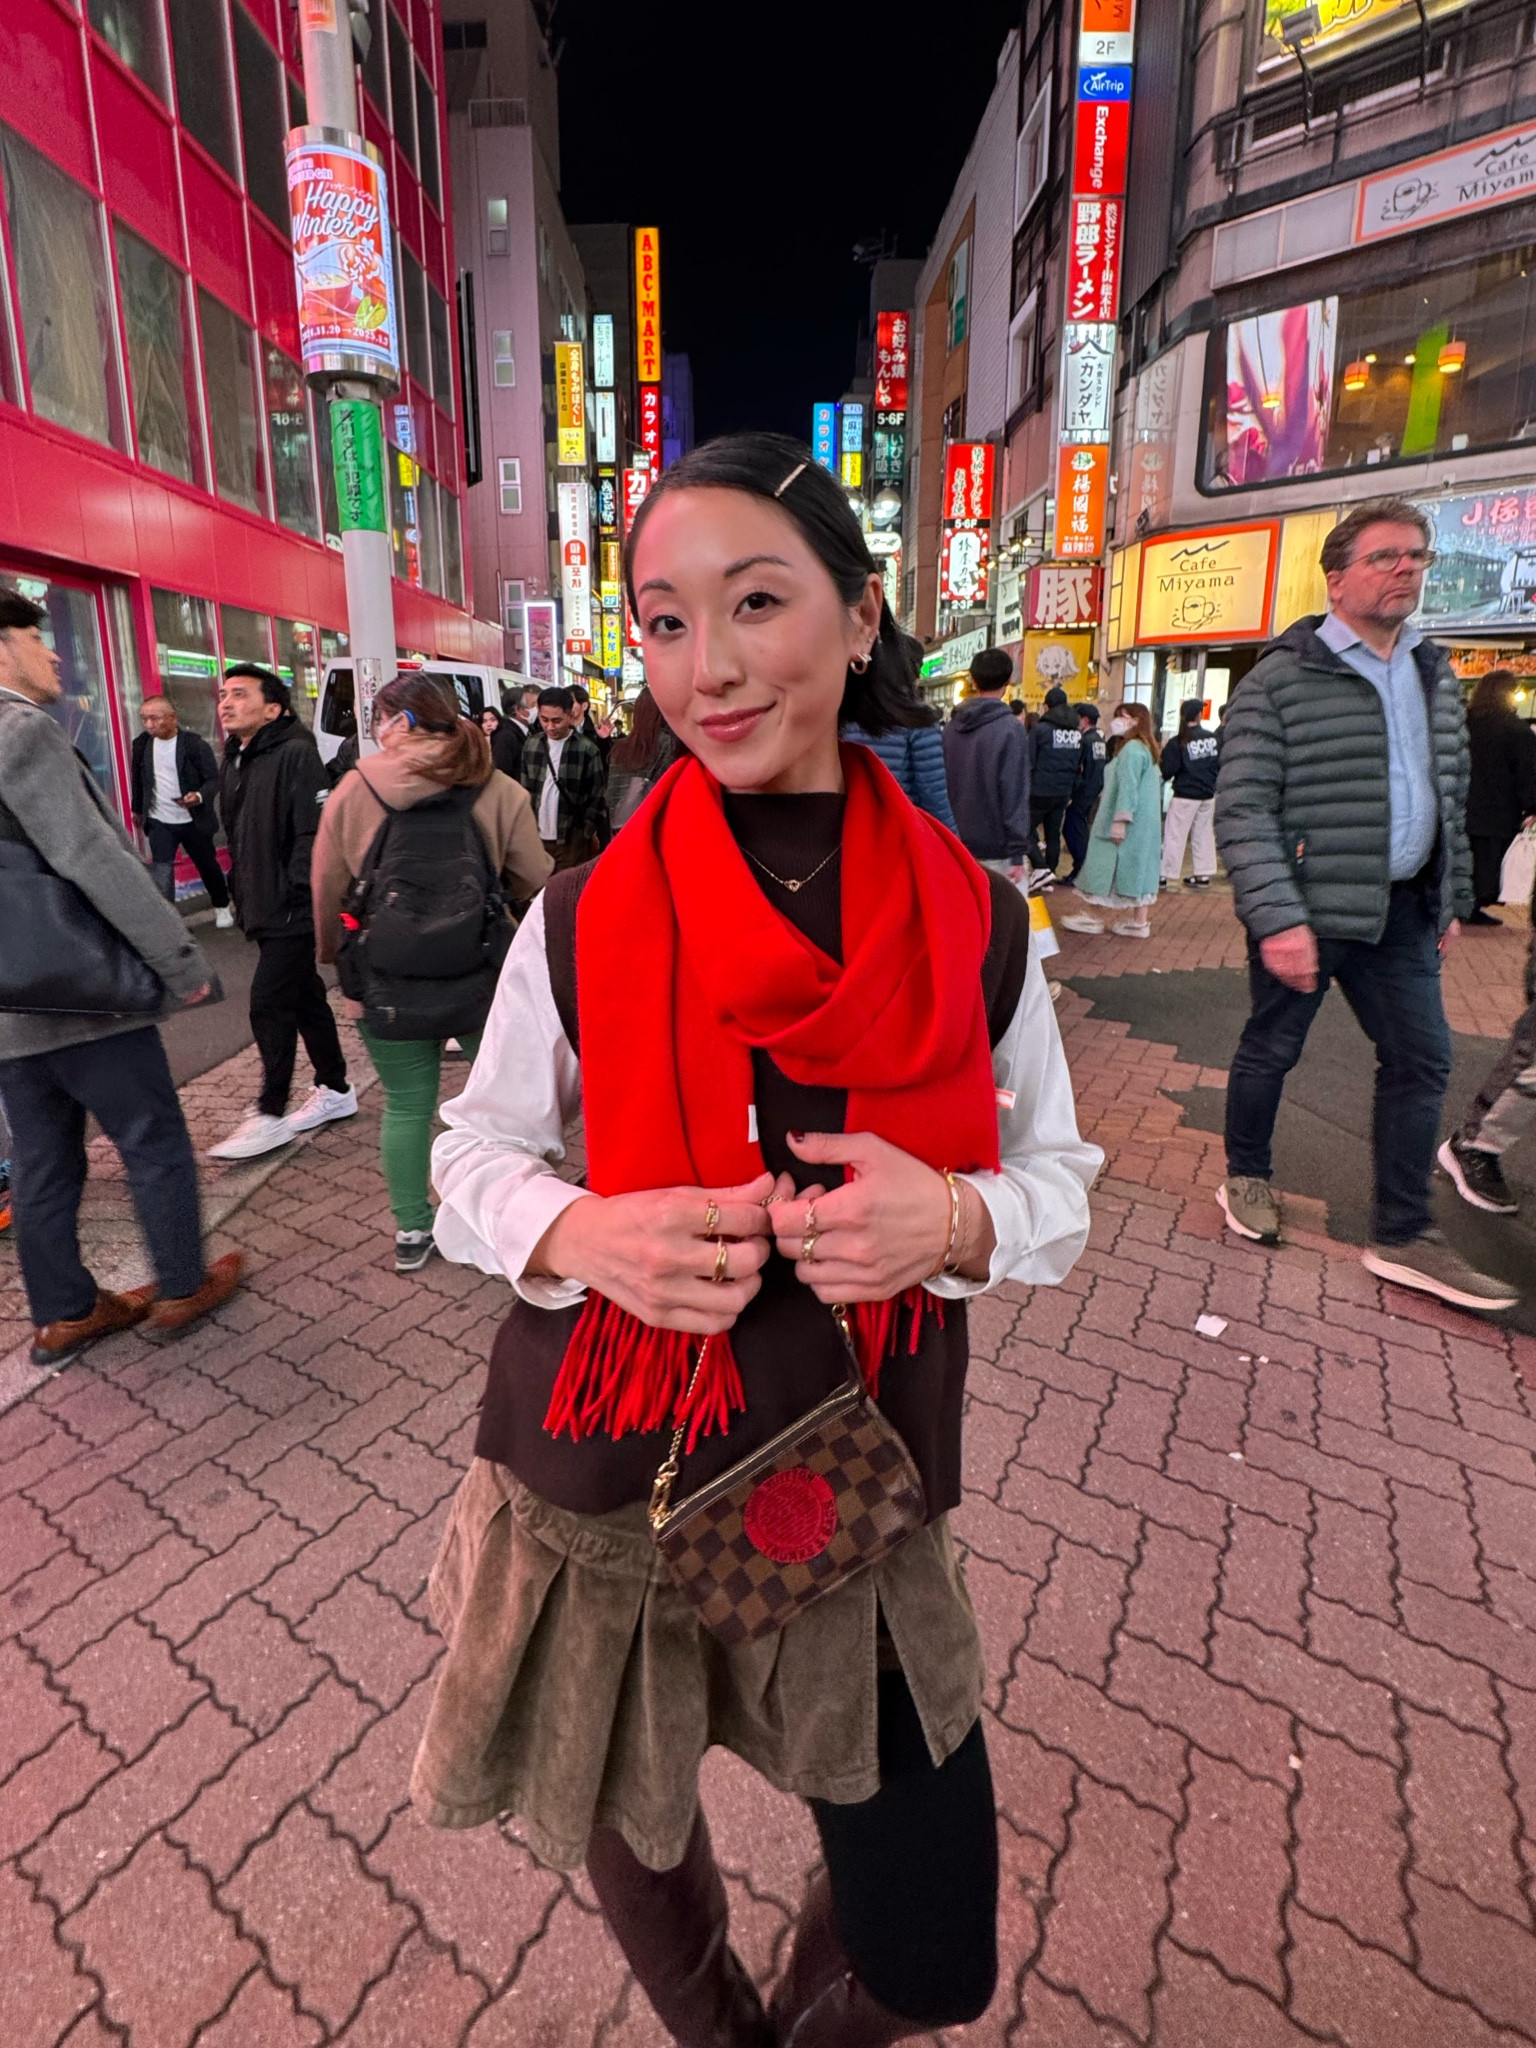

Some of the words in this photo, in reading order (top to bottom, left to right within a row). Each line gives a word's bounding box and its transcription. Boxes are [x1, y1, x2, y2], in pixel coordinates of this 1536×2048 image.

[1096, 40, 1115, 55] 2F
[1091, 77, 1124, 94] AirTrip
[1089, 105, 1109, 189] Exchange
[1484, 151, 1529, 176] Cafe
[292, 209, 357, 245] Winter
[304, 180, 378, 233] Happy
[1072, 201, 1101, 319] 野郎ラーメン
[641, 234, 656, 375] ABC-MART
[890, 318, 906, 379] お好み焼
[570, 348, 581, 426] 全身もみほぐし
[877, 349, 892, 406] もんじゃ
[890, 433, 904, 473] いびき
[1159, 574, 1235, 594] Miyama
[1179, 556, 1217, 573] Cafe
[1035, 568, 1092, 624] 豚
[571, 641, 586, 652] B1
